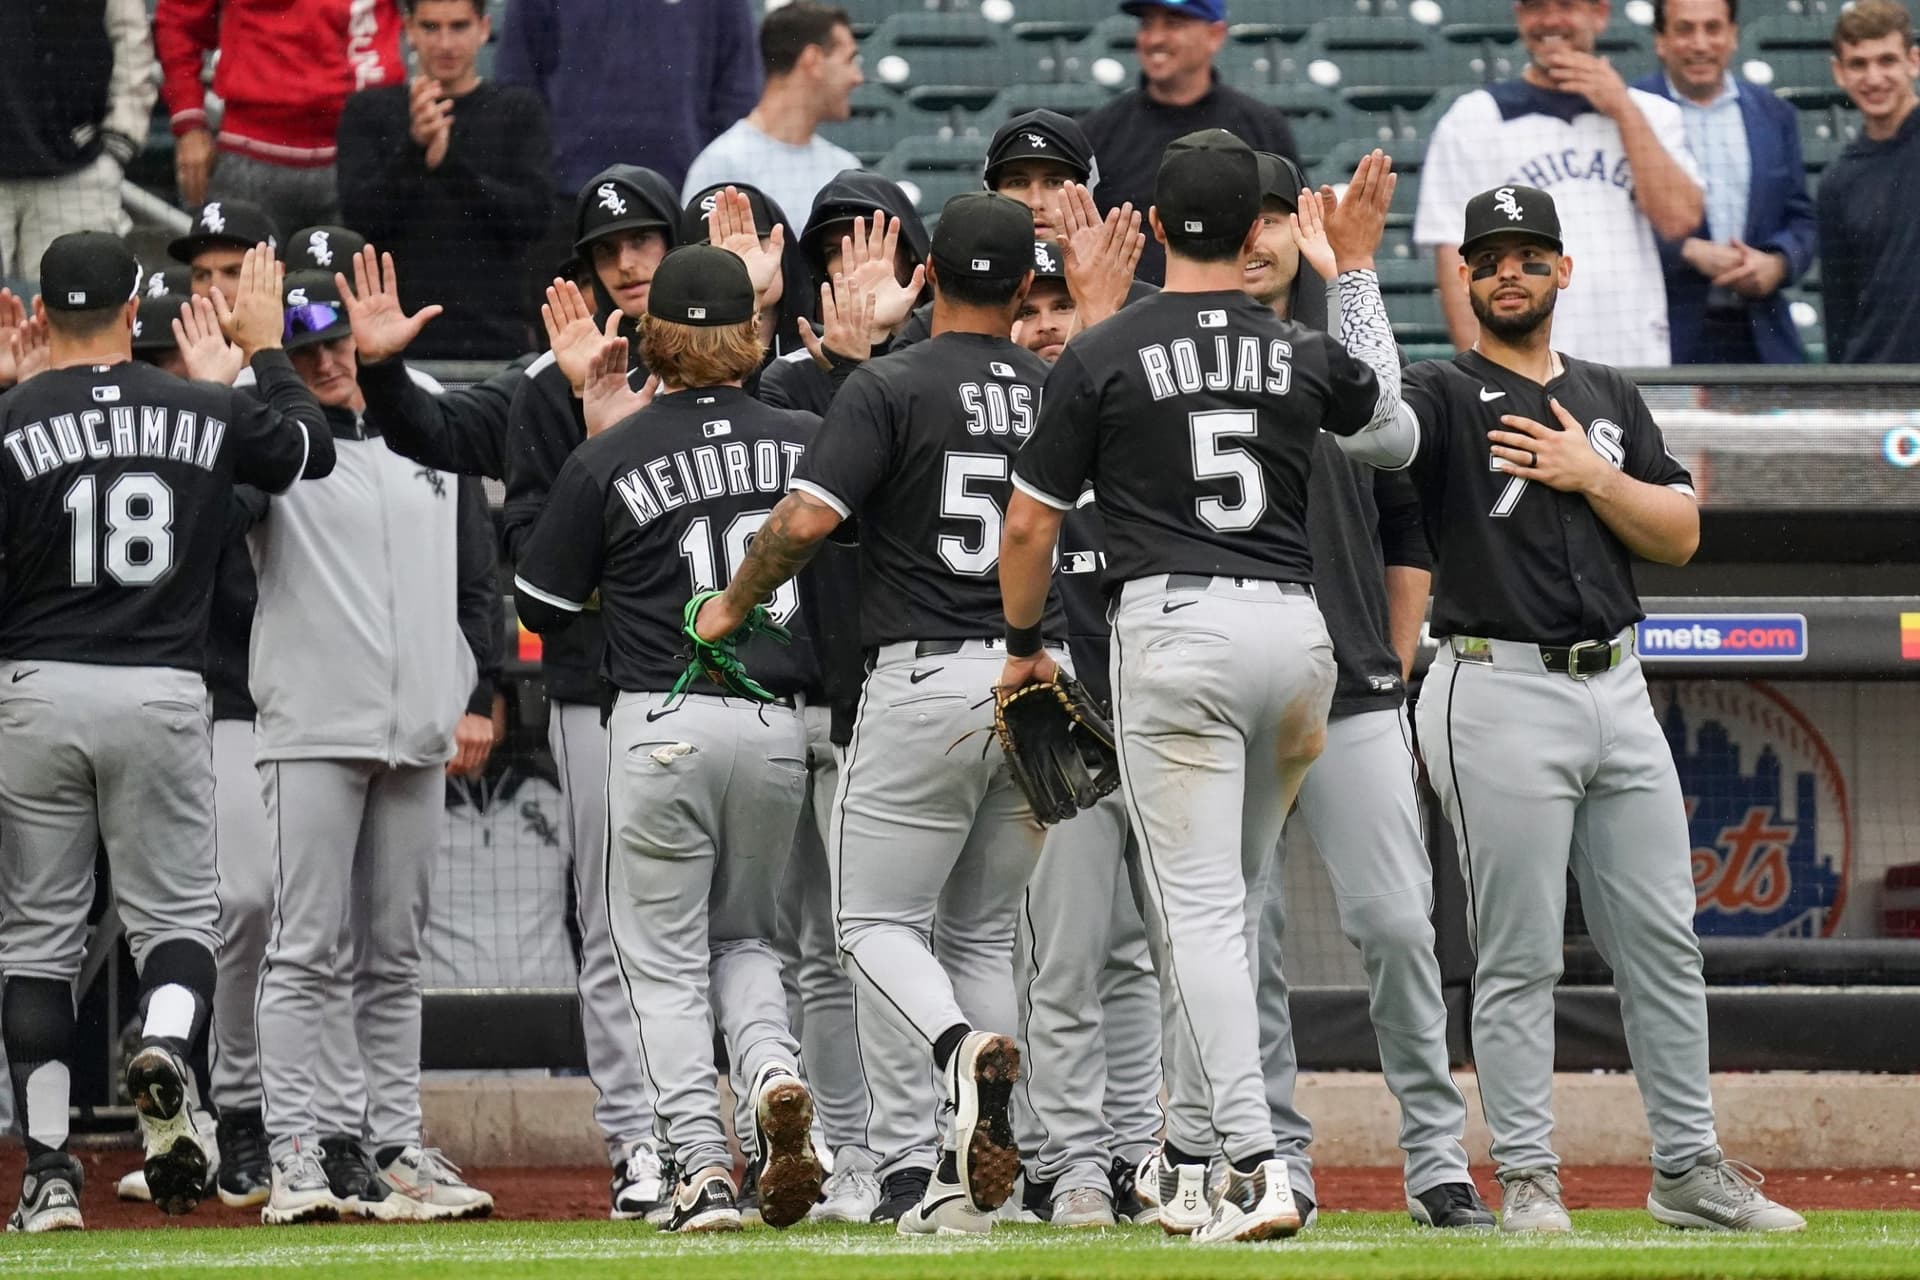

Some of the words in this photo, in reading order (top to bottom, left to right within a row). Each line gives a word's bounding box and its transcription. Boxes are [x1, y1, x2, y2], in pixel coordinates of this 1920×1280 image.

[1506, 149, 1637, 203] HICAG
[1138, 336, 1293, 401] ROJAS
[4, 405, 227, 481] TAUCHMAN
[959, 382, 1034, 436] SOS
[613, 440, 806, 527] MEIDROT
[1188, 409, 1268, 532] 5
[63, 472, 174, 587] 18
[1645, 624, 1796, 649] mets.com
[1682, 796, 1798, 915] ets
[1697, 1198, 1738, 1219] marucci
